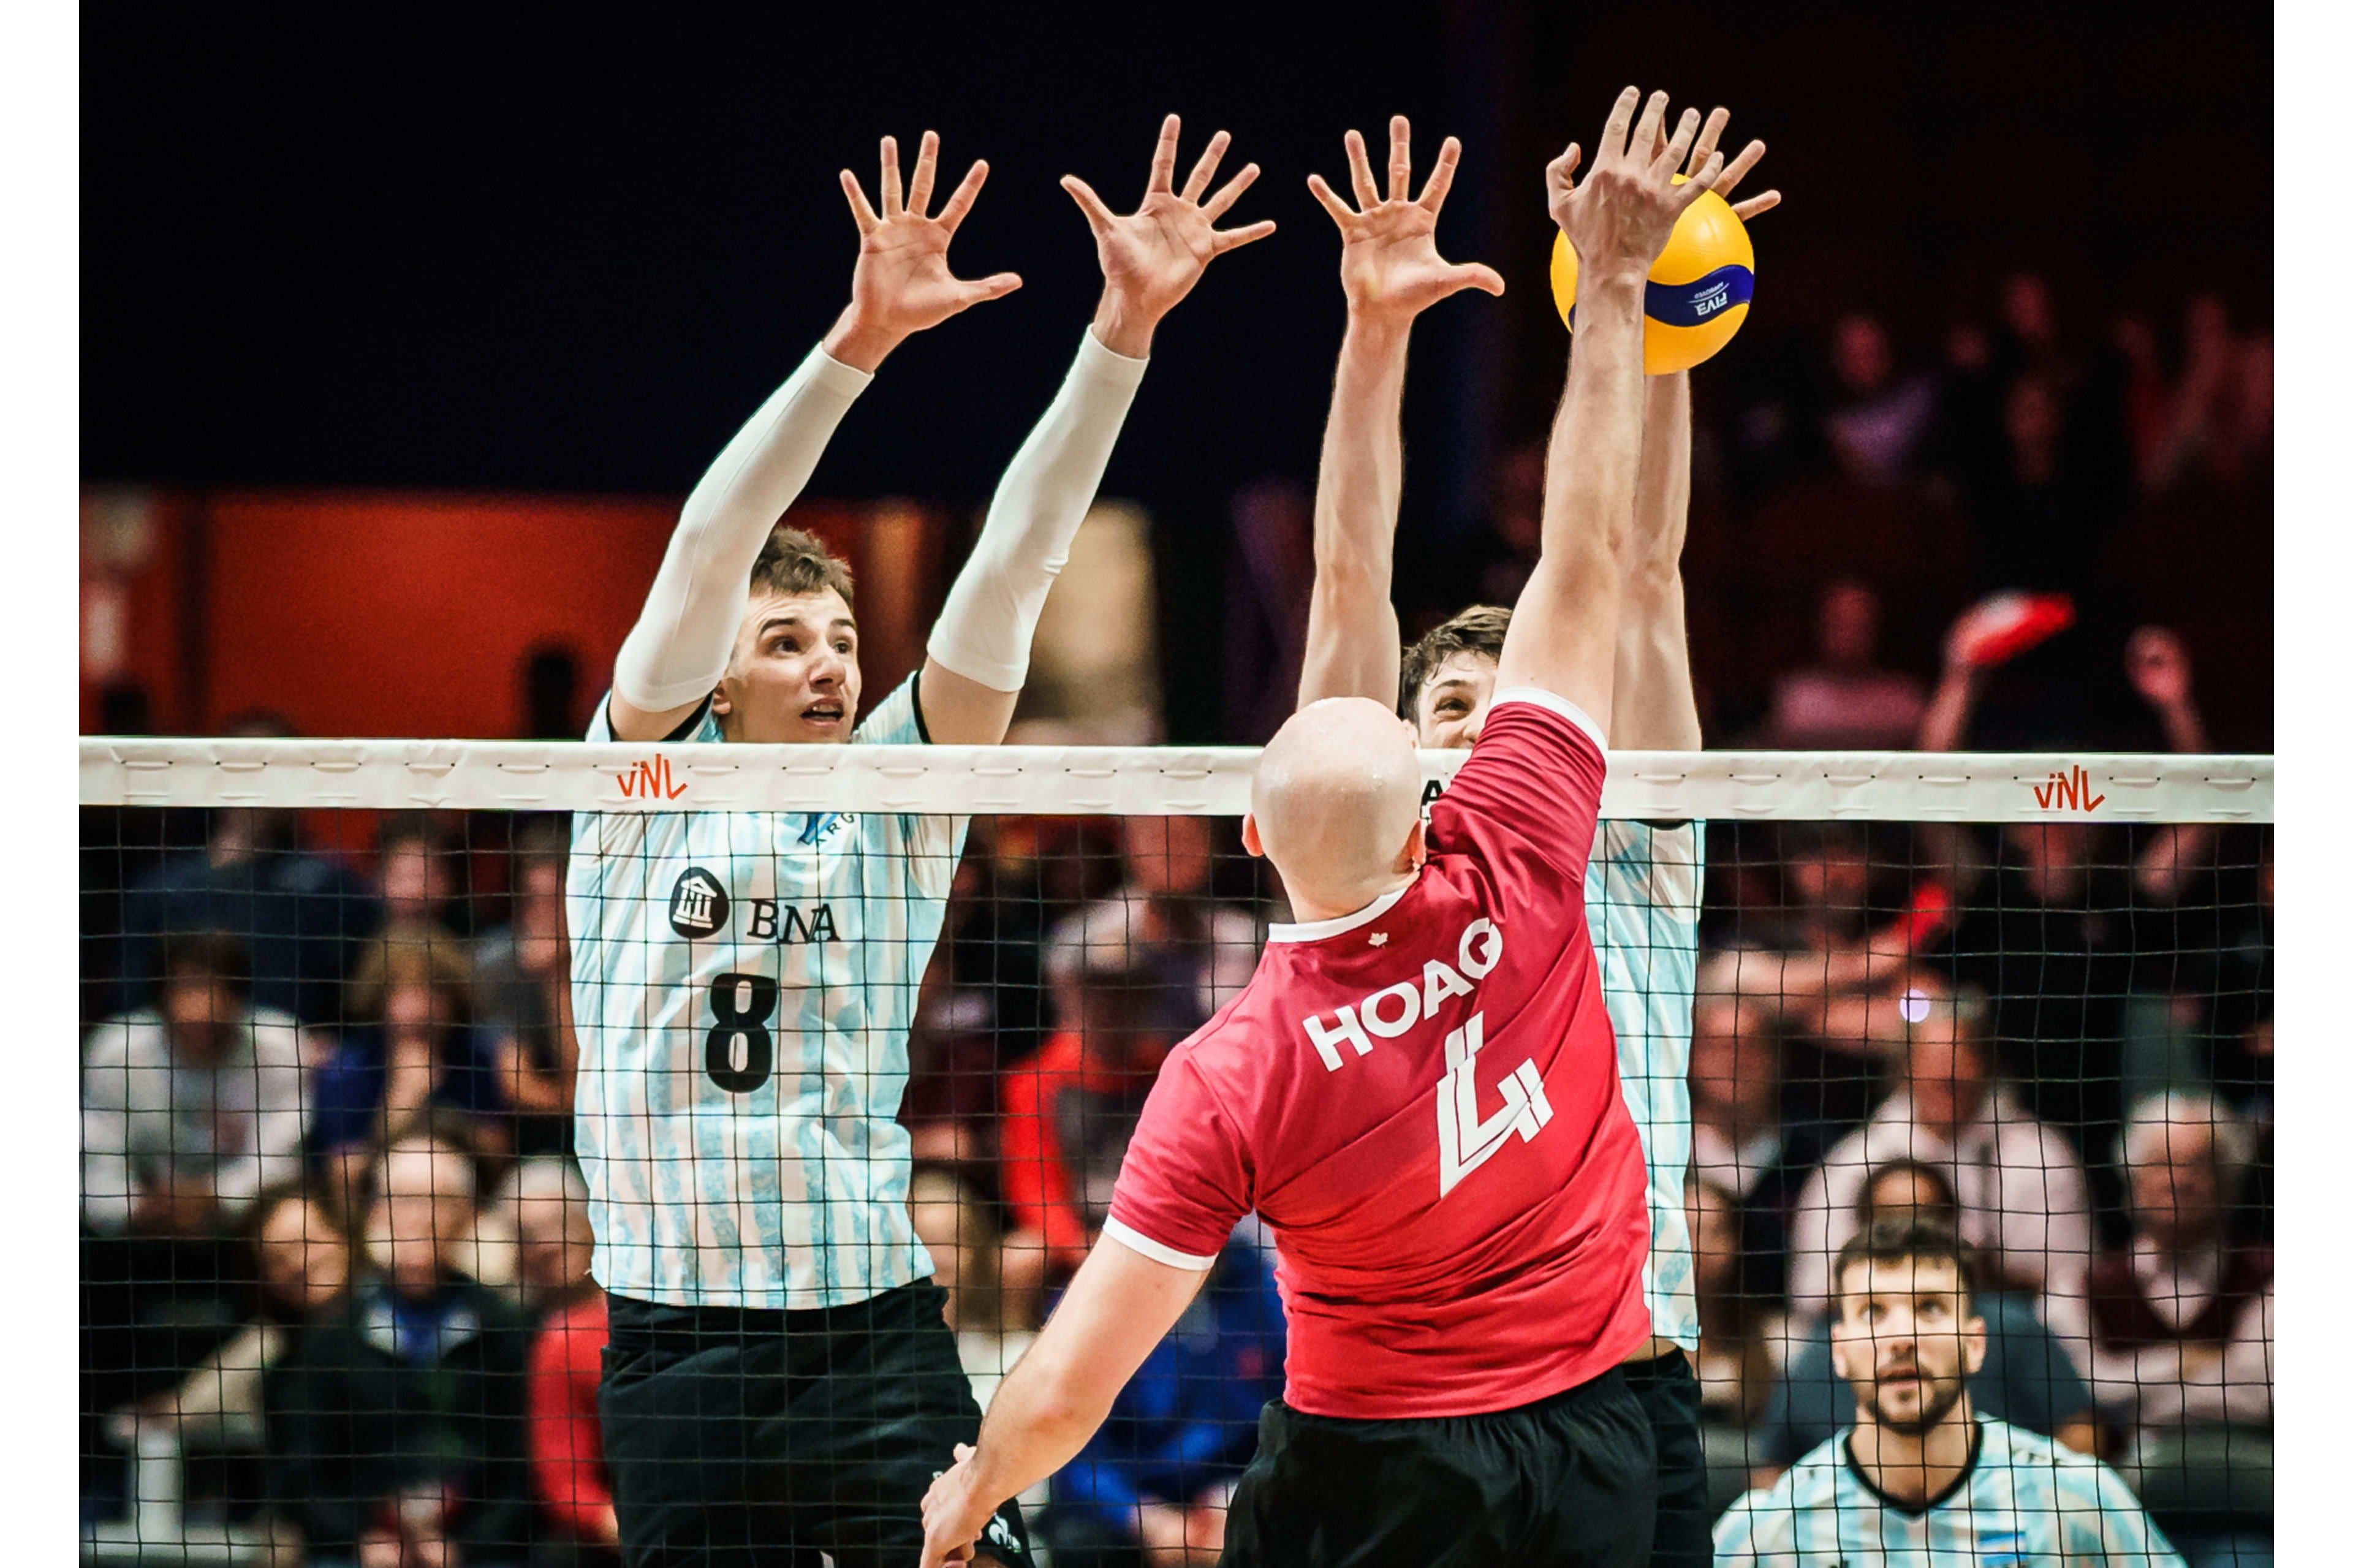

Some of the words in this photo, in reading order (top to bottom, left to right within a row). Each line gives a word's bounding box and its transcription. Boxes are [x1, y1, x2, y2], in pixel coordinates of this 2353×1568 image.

[747, 898, 841, 944] BNA
[705, 972, 778, 1094] 8
[1302, 917, 1503, 1072] HOAG
[1436, 1010, 1555, 1199] 4
